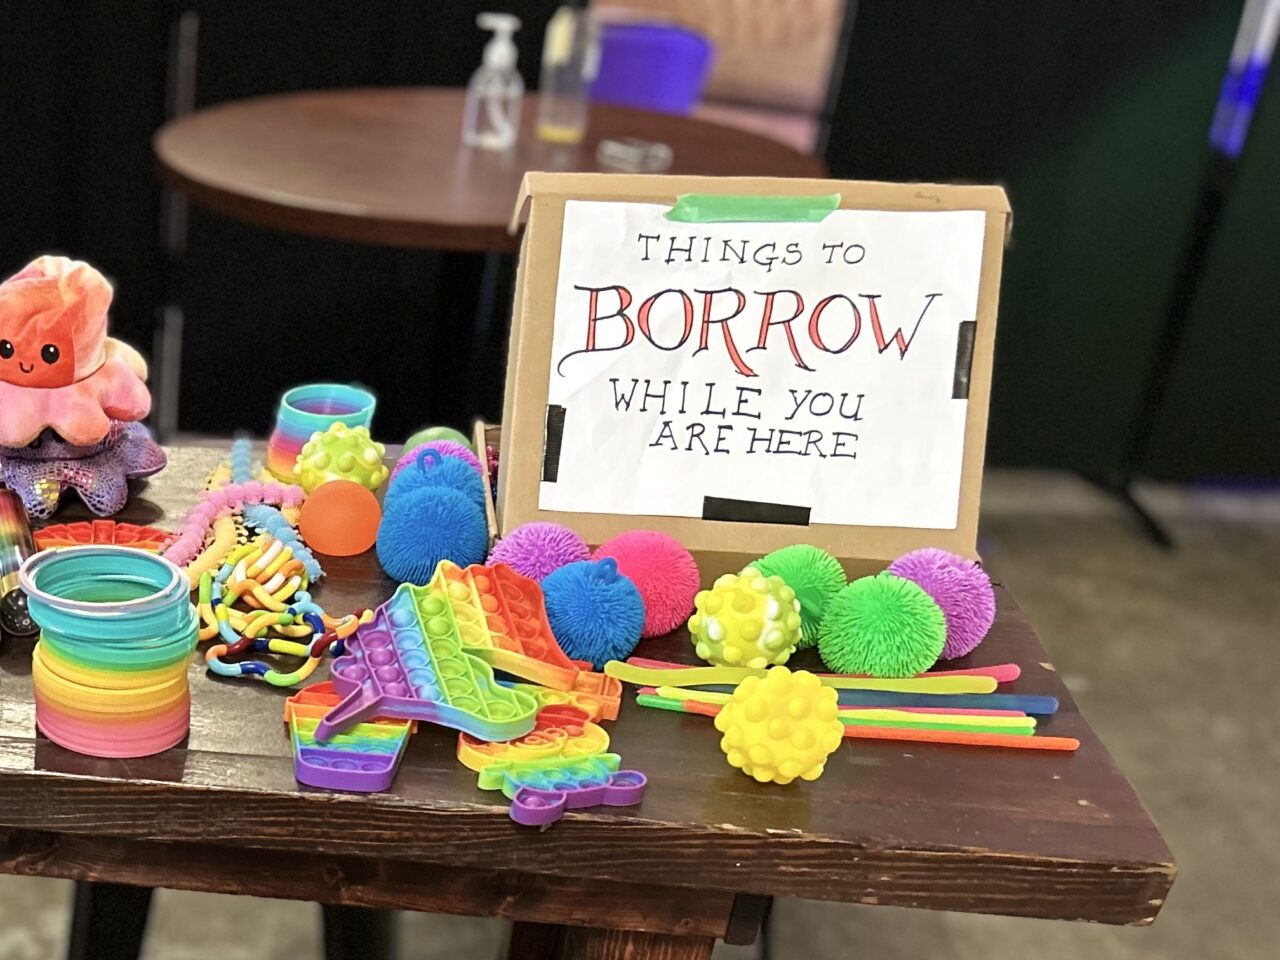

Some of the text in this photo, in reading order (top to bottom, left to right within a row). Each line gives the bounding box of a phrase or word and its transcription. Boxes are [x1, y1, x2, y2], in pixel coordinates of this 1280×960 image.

[638, 233, 866, 272] THINGS TO
[557, 285, 944, 378] BORROW
[610, 378, 762, 420] WHILE
[649, 421, 858, 459] ARE HERE
